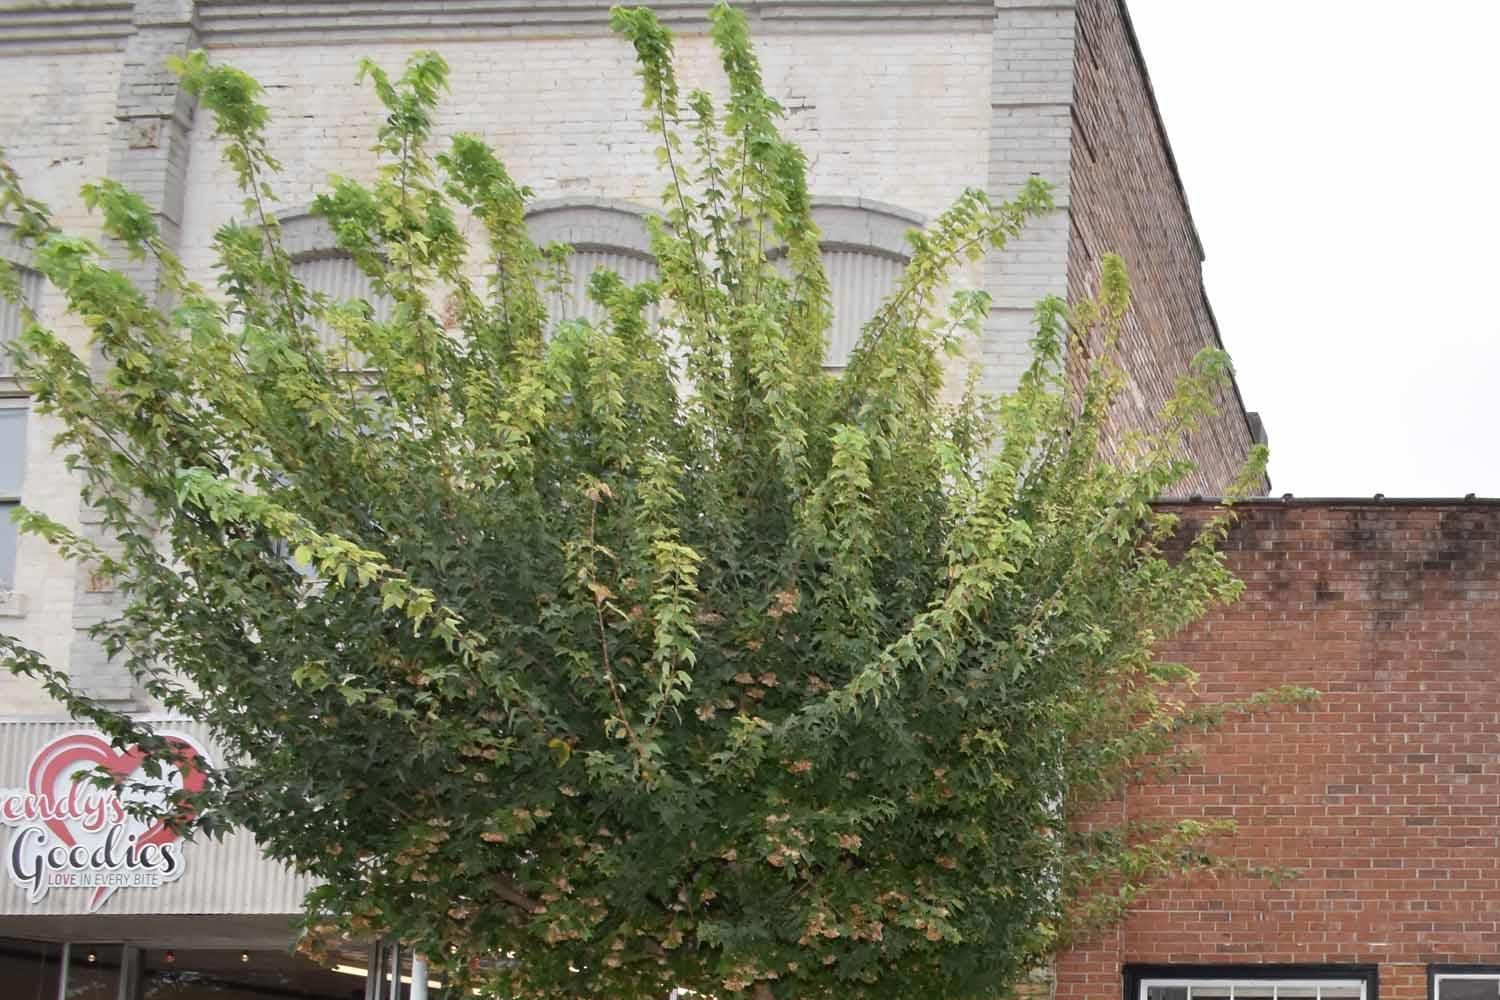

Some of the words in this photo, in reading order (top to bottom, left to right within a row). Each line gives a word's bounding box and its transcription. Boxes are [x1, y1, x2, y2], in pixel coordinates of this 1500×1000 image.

[0, 780, 126, 831] endy's
[12, 824, 176, 893] Goodies
[50, 873, 76, 885] LOVE
[80, 873, 91, 885] IN
[94, 873, 130, 885] EVERY
[134, 873, 158, 885] BITE
